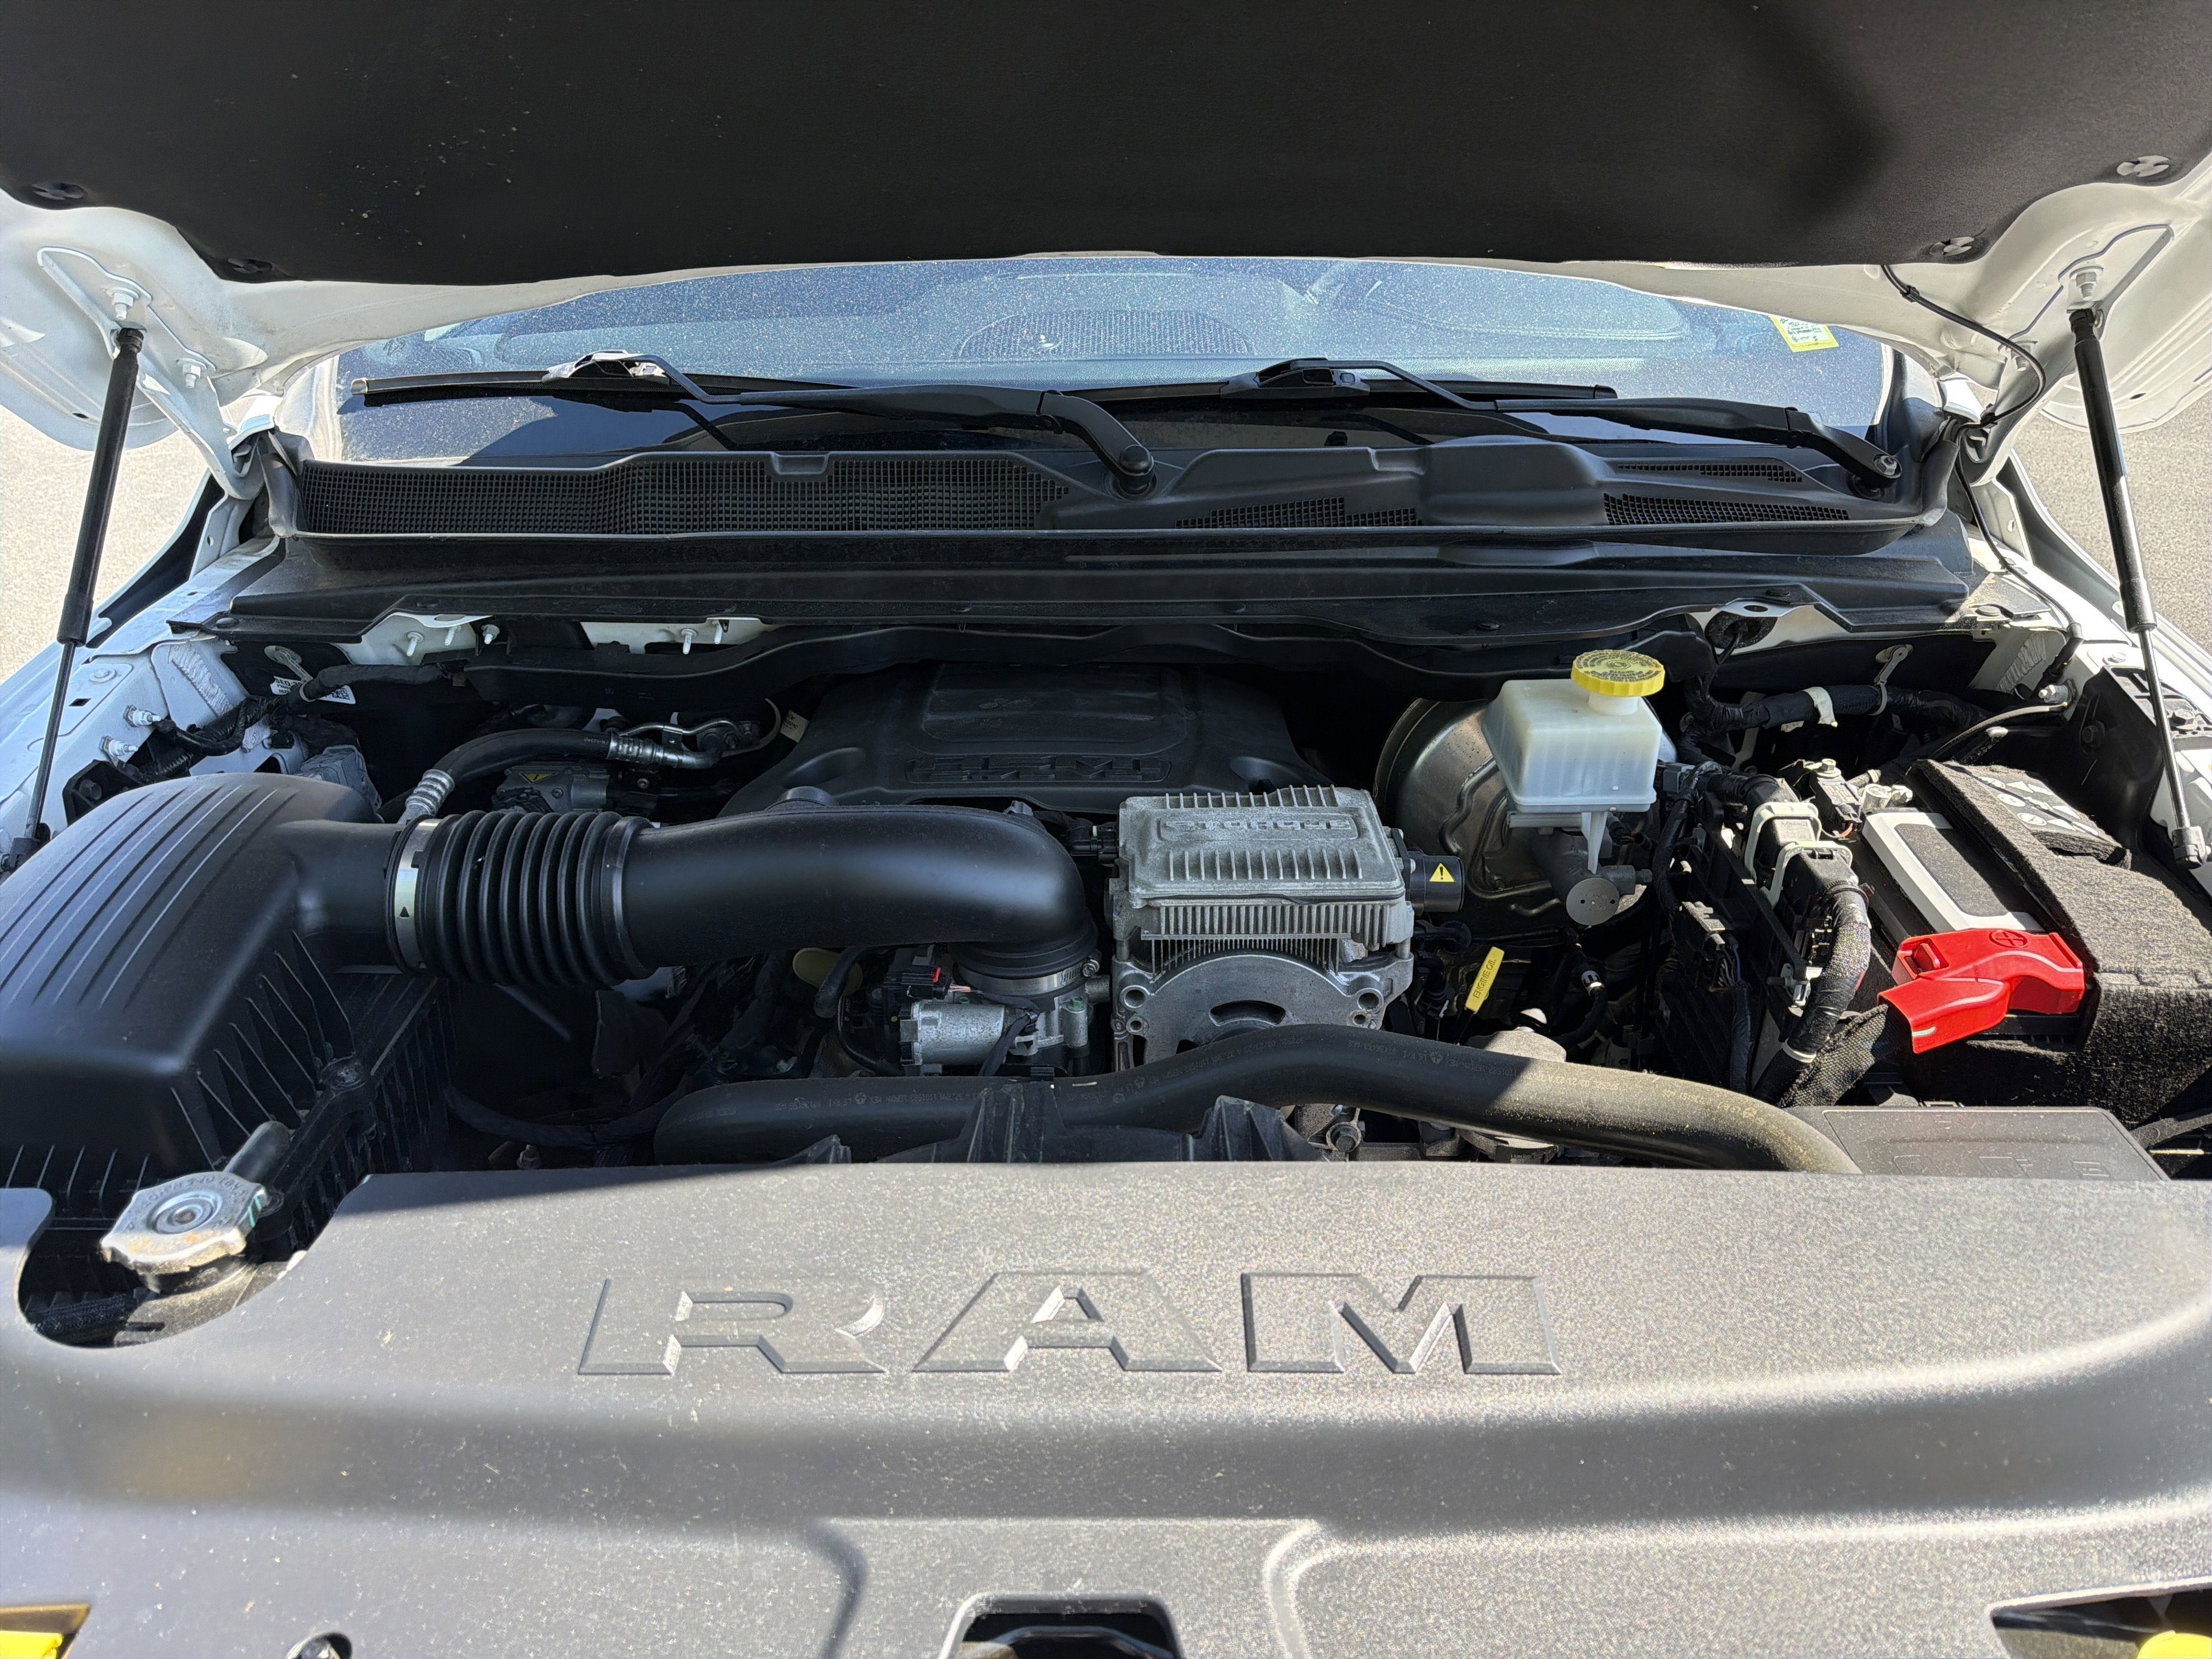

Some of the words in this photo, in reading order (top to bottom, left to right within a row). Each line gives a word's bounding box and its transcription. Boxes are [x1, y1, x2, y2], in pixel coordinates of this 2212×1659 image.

[1472, 969, 1491, 999] ENGINE
[1486, 958, 1498, 970] OIL
[579, 1271, 1561, 1375] RAM
